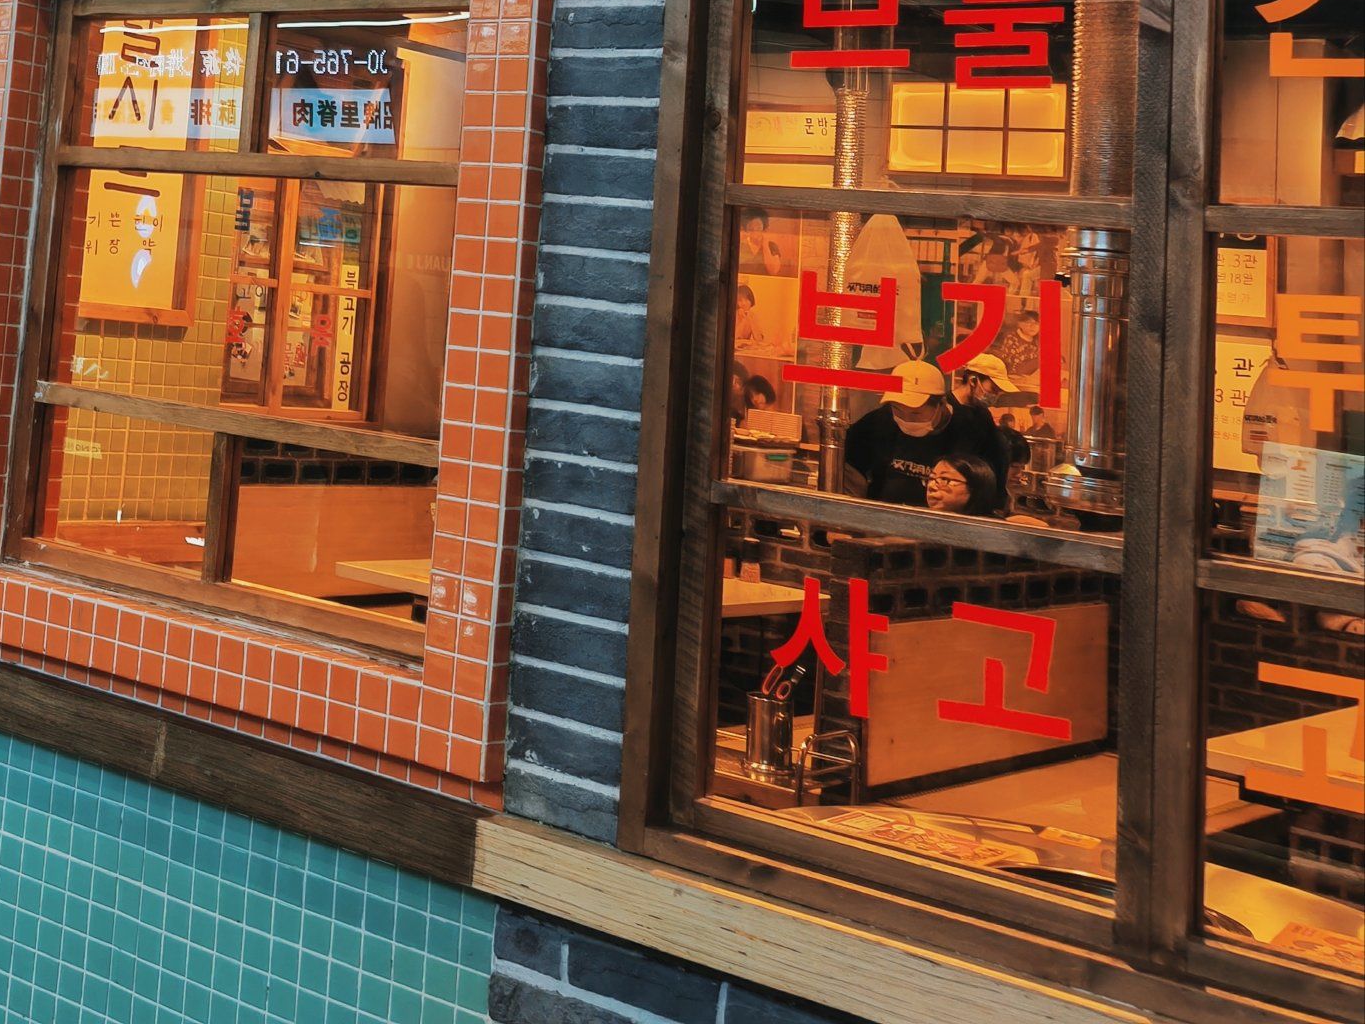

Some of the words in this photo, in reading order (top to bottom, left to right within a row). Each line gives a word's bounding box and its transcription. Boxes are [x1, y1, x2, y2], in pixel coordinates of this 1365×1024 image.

[936, 280, 1062, 409] 기
[771, 576, 890, 719] 샤
[938, 601, 1072, 741] 고
